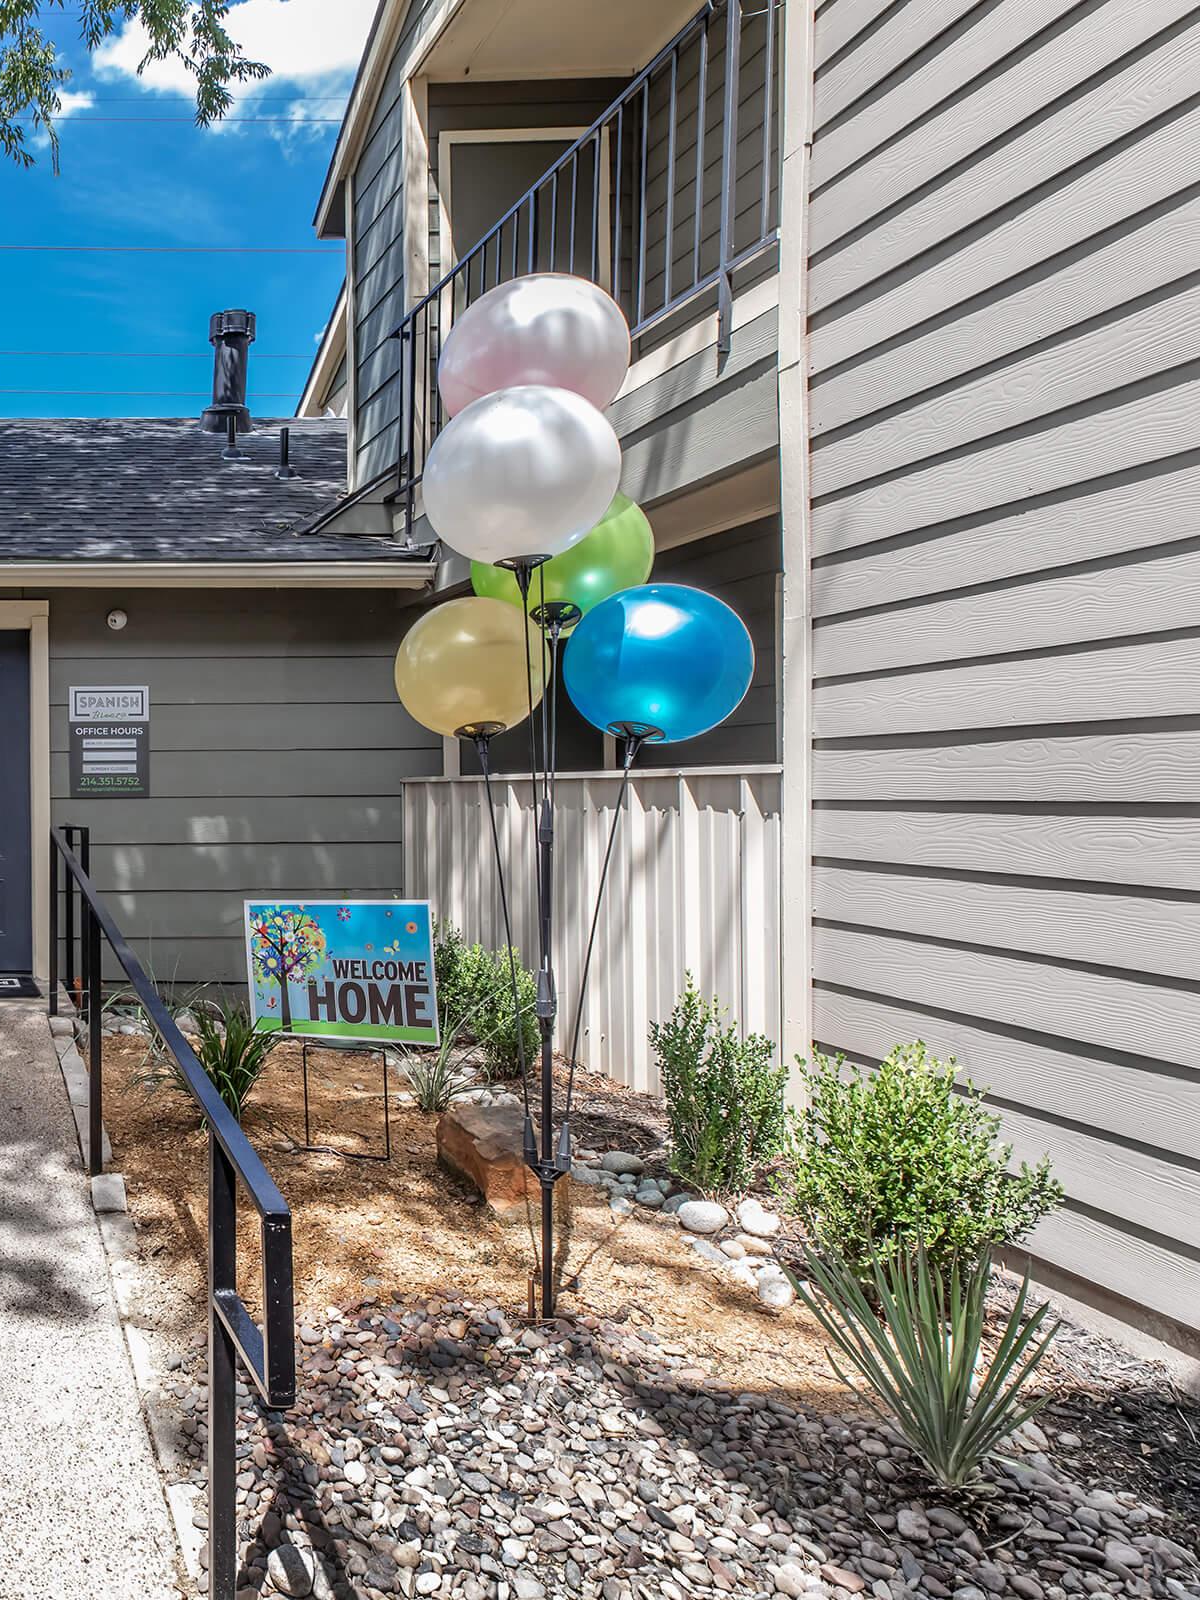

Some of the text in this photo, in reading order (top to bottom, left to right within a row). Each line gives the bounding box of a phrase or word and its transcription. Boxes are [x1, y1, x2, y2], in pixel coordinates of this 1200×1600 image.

[80, 696, 139, 708] SPANISH
[75, 727, 144, 735] OFFICE HOURS
[80, 777, 140, 786] 214.351.5752
[332, 959, 427, 982] WELCOME
[308, 981, 432, 1028] HOME
